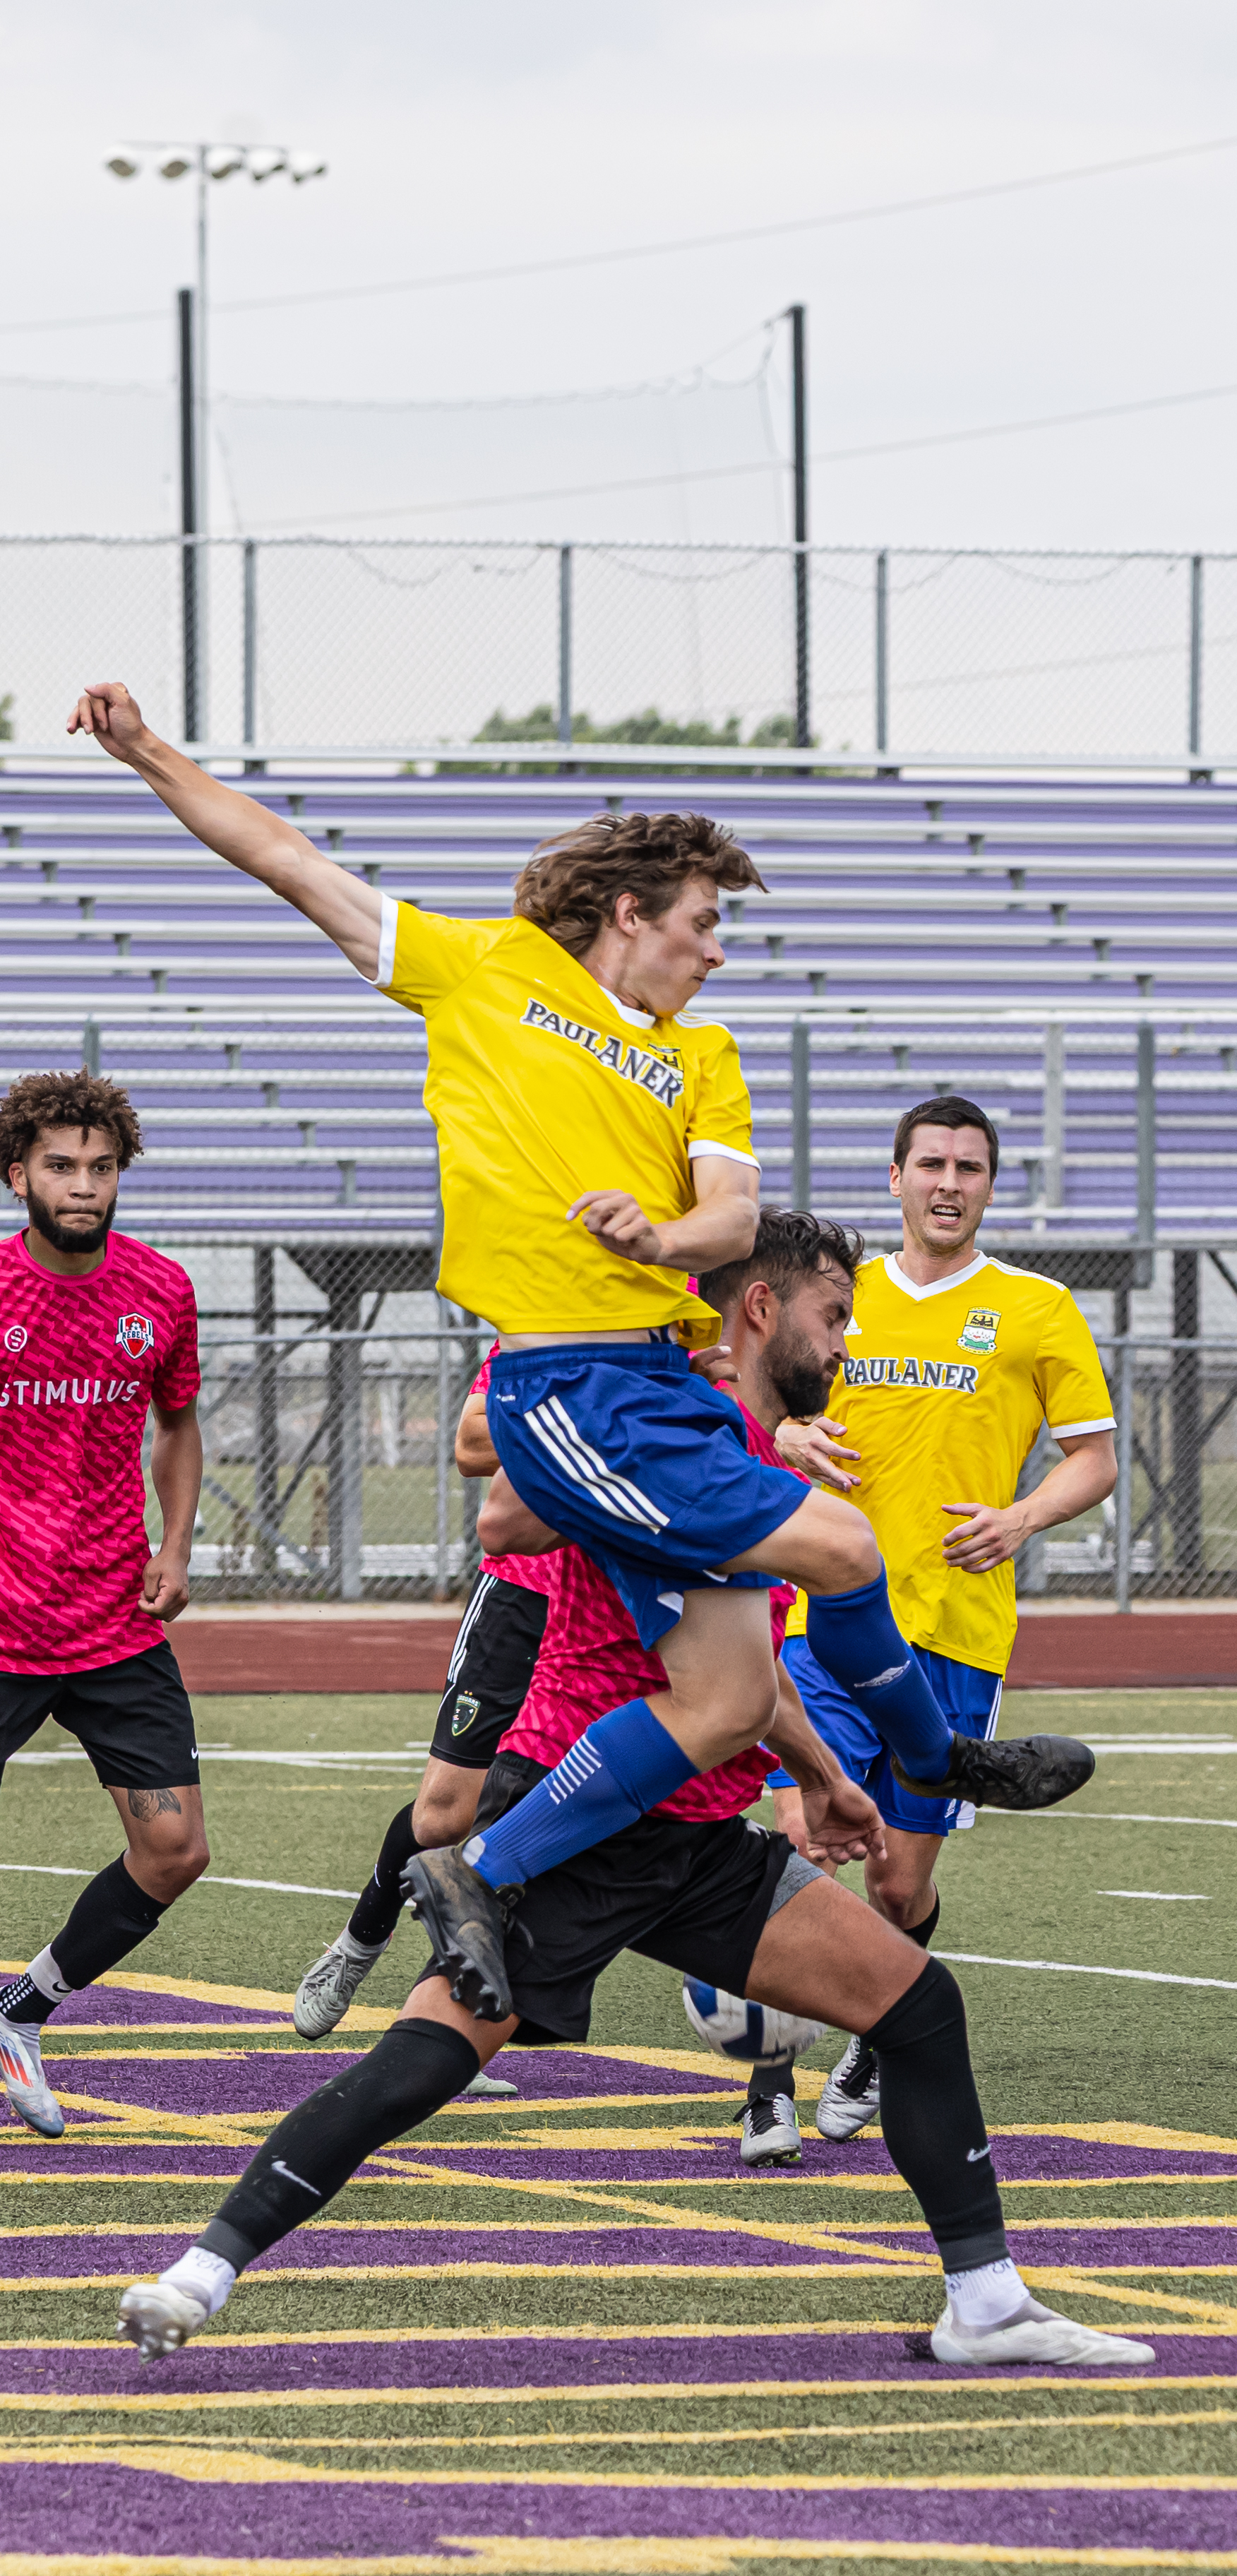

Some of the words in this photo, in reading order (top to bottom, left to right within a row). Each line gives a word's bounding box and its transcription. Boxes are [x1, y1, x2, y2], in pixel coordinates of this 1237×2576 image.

[522, 998, 683, 1108] PAULANER
[121, 1330, 149, 1342] REBELS
[843, 1357, 977, 1394] PAULANER
